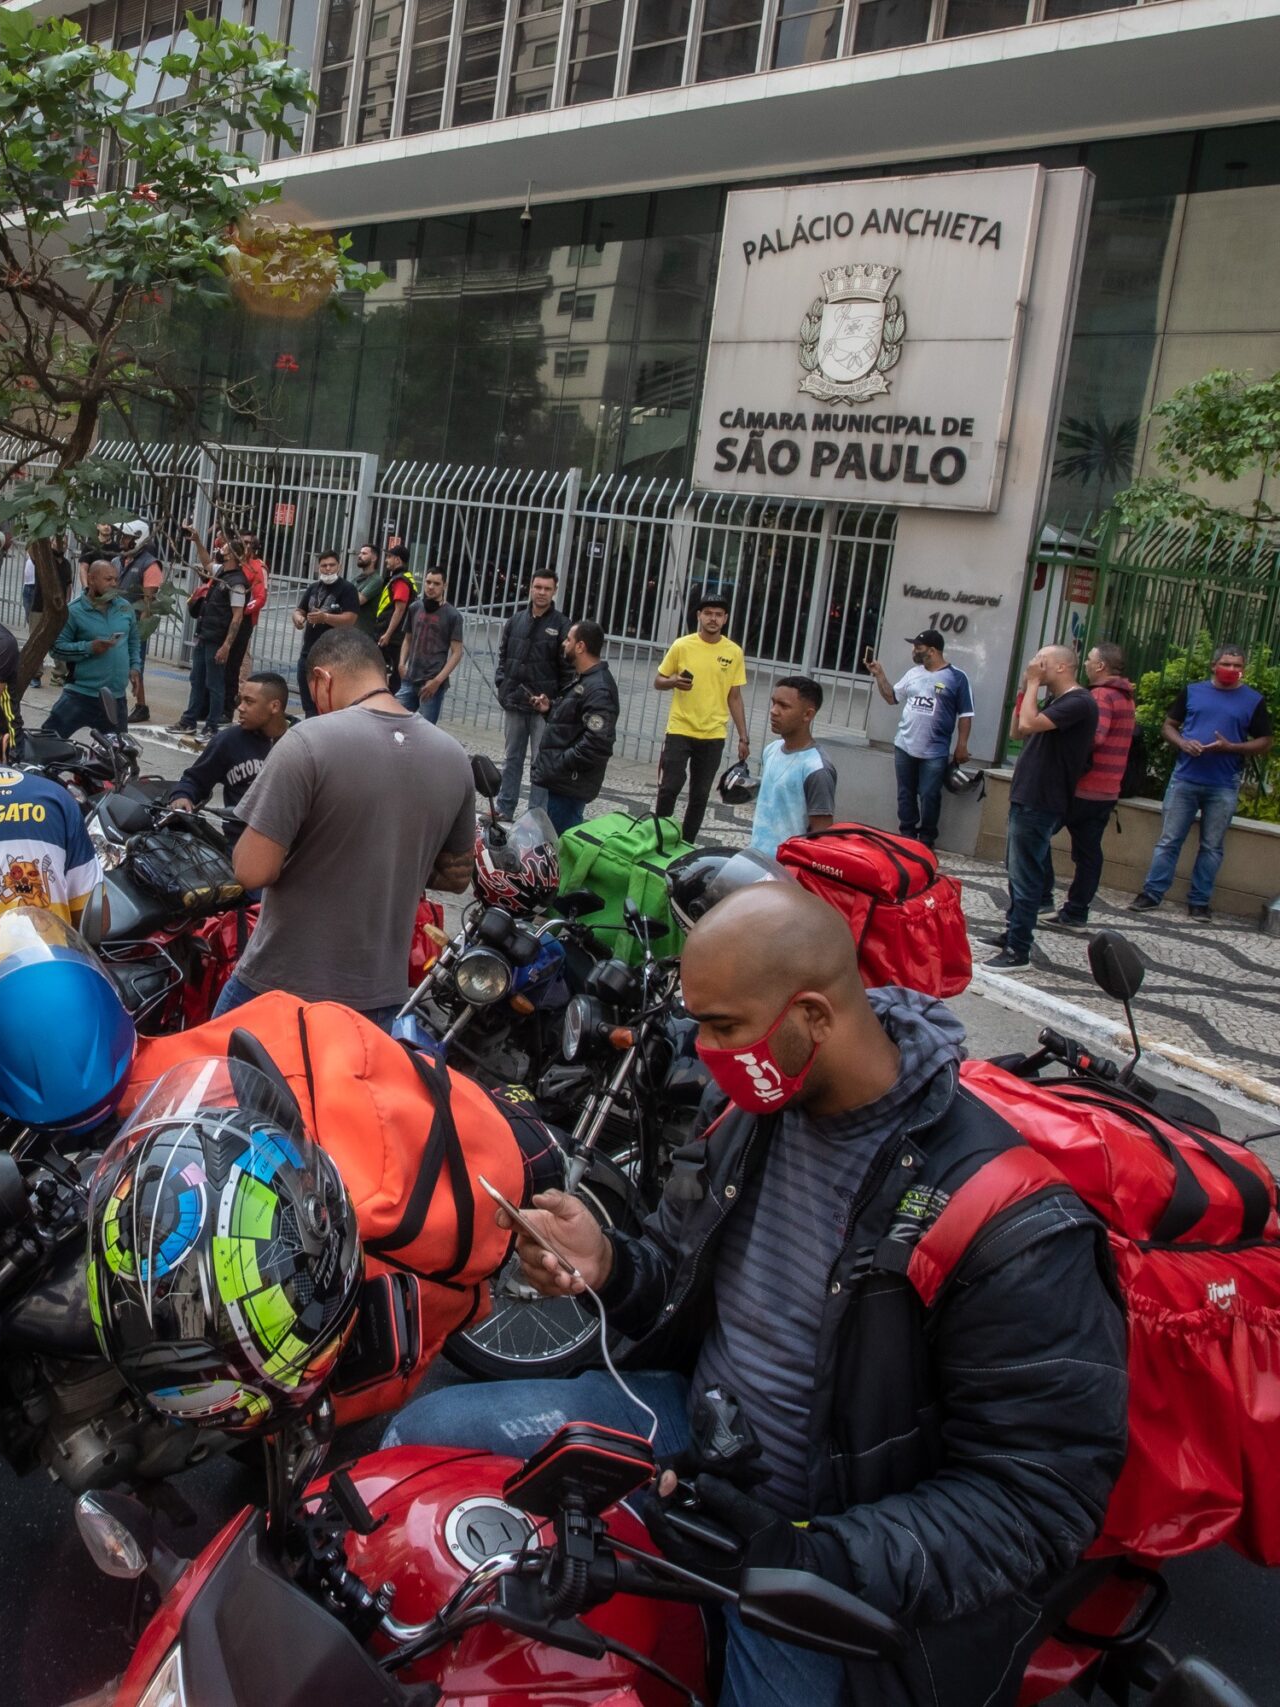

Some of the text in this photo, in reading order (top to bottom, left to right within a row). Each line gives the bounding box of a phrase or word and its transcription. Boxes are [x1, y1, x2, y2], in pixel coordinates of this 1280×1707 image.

[742, 207, 1003, 265] PALÁCIO ANCHIETA
[719, 406, 974, 437] CÂMARA MUNICIPAL DE
[713, 430, 967, 486] SÃO PAULO
[902, 583, 951, 602] Viaduto
[928, 611, 969, 634] 100
[914, 696, 934, 708] TCS
